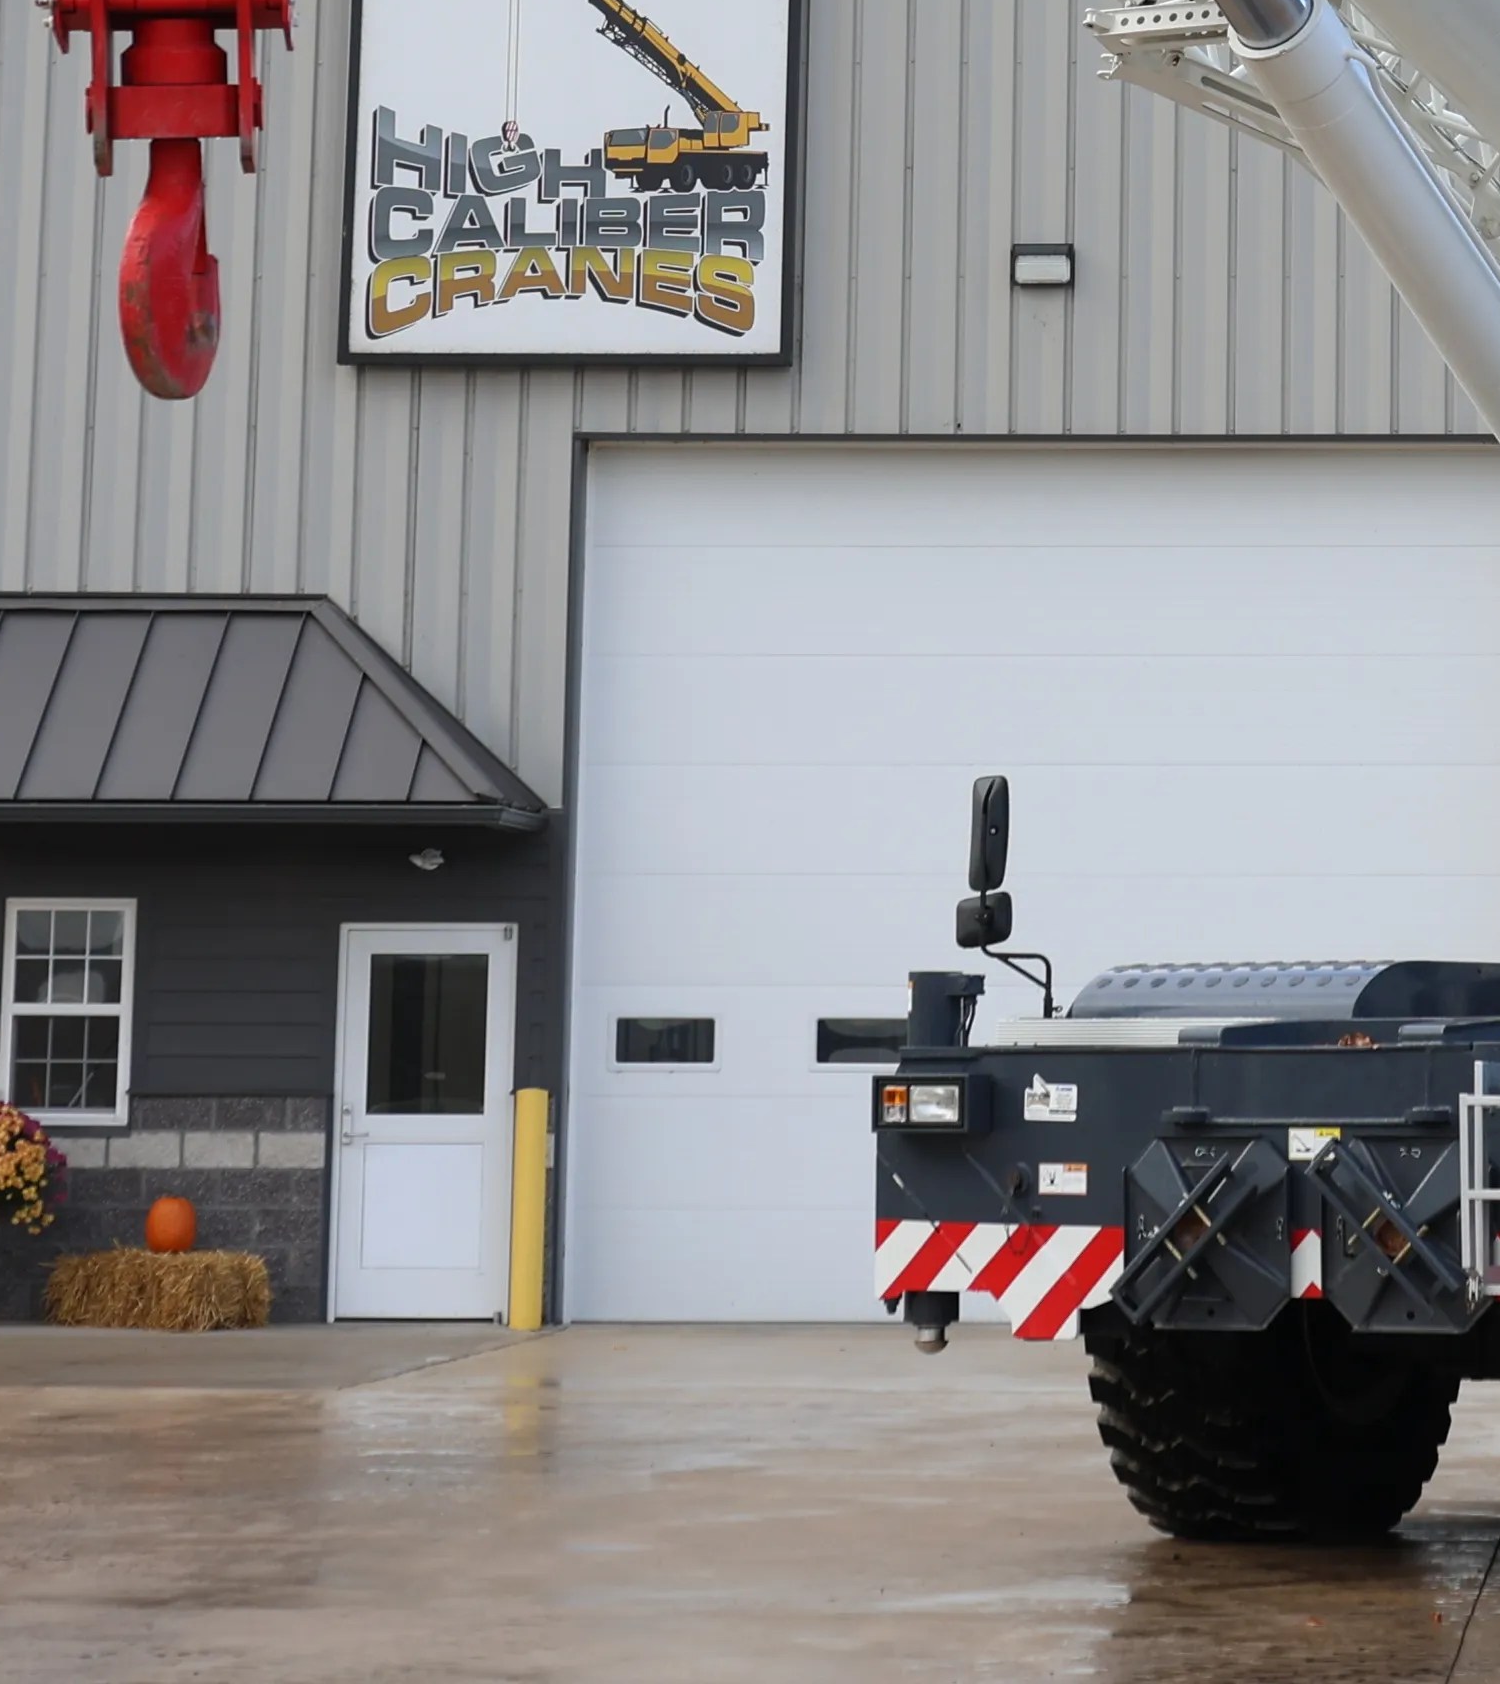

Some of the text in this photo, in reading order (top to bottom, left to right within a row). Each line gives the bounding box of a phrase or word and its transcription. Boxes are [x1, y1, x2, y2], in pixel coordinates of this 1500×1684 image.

[372, 105, 607, 204] HIGH
[368, 186, 767, 266] CALIBER
[367, 246, 756, 339] CRANES
